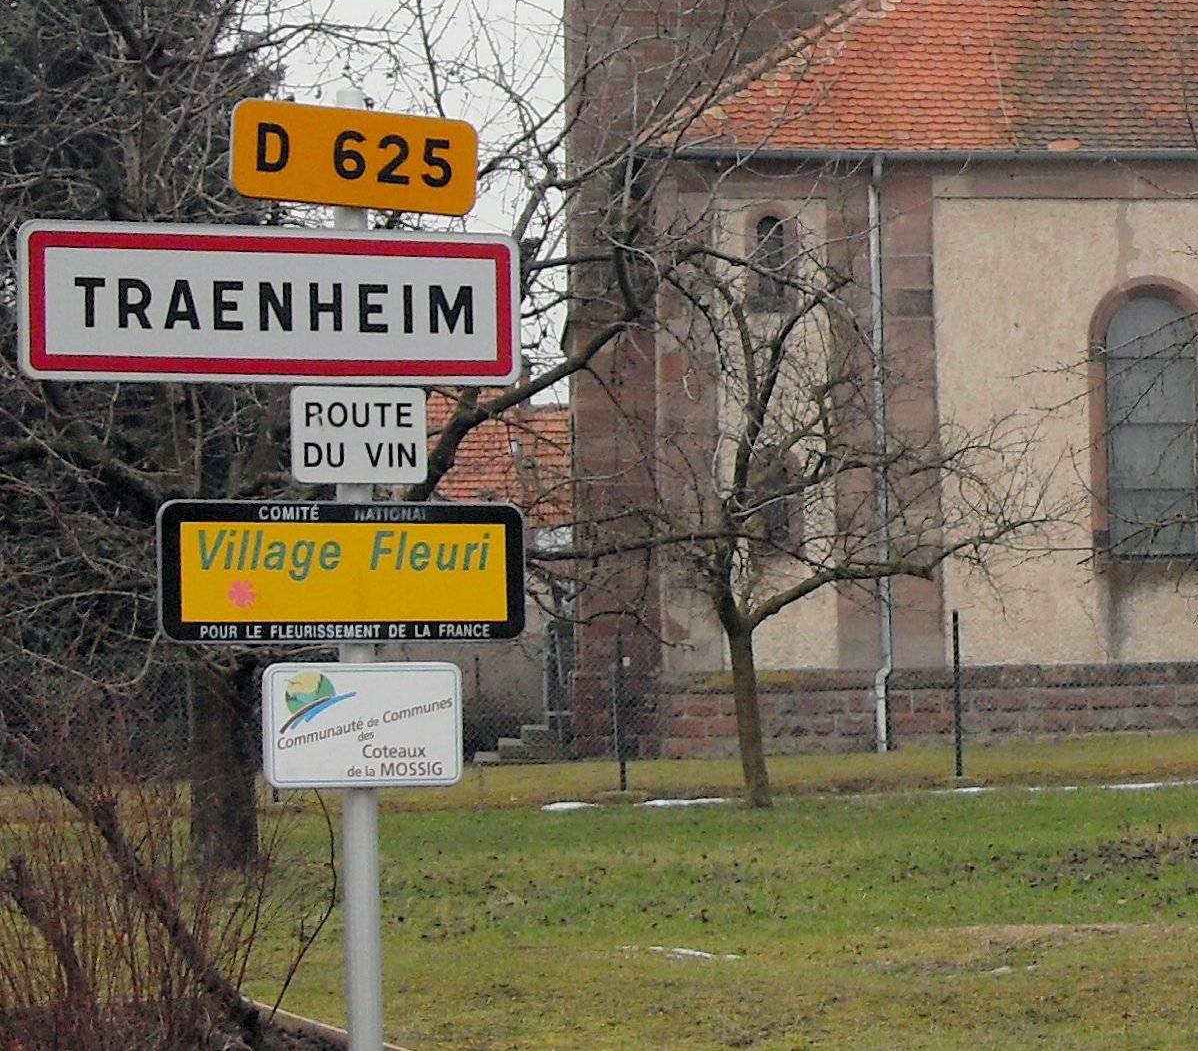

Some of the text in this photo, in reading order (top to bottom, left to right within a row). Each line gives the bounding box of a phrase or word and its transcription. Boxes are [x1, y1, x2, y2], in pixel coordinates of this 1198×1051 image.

[256, 122, 453, 188] D 625
[74, 276, 474, 335] TRAENHEIM
[304, 402, 413, 428] ROUTE
[304, 442, 418, 468] DU VIN
[258, 504, 320, 521] COMITÉ
[197, 529, 491, 582] Village Fleuri
[200, 623, 491, 639] POUR LE FLEURISSEMENT DE LA FRANCE
[277, 697, 454, 750] Communauté de Communes
[357, 730, 375, 742] des
[362, 744, 426, 759] Coteaux
[347, 761, 443, 778] de la MOSSIG
